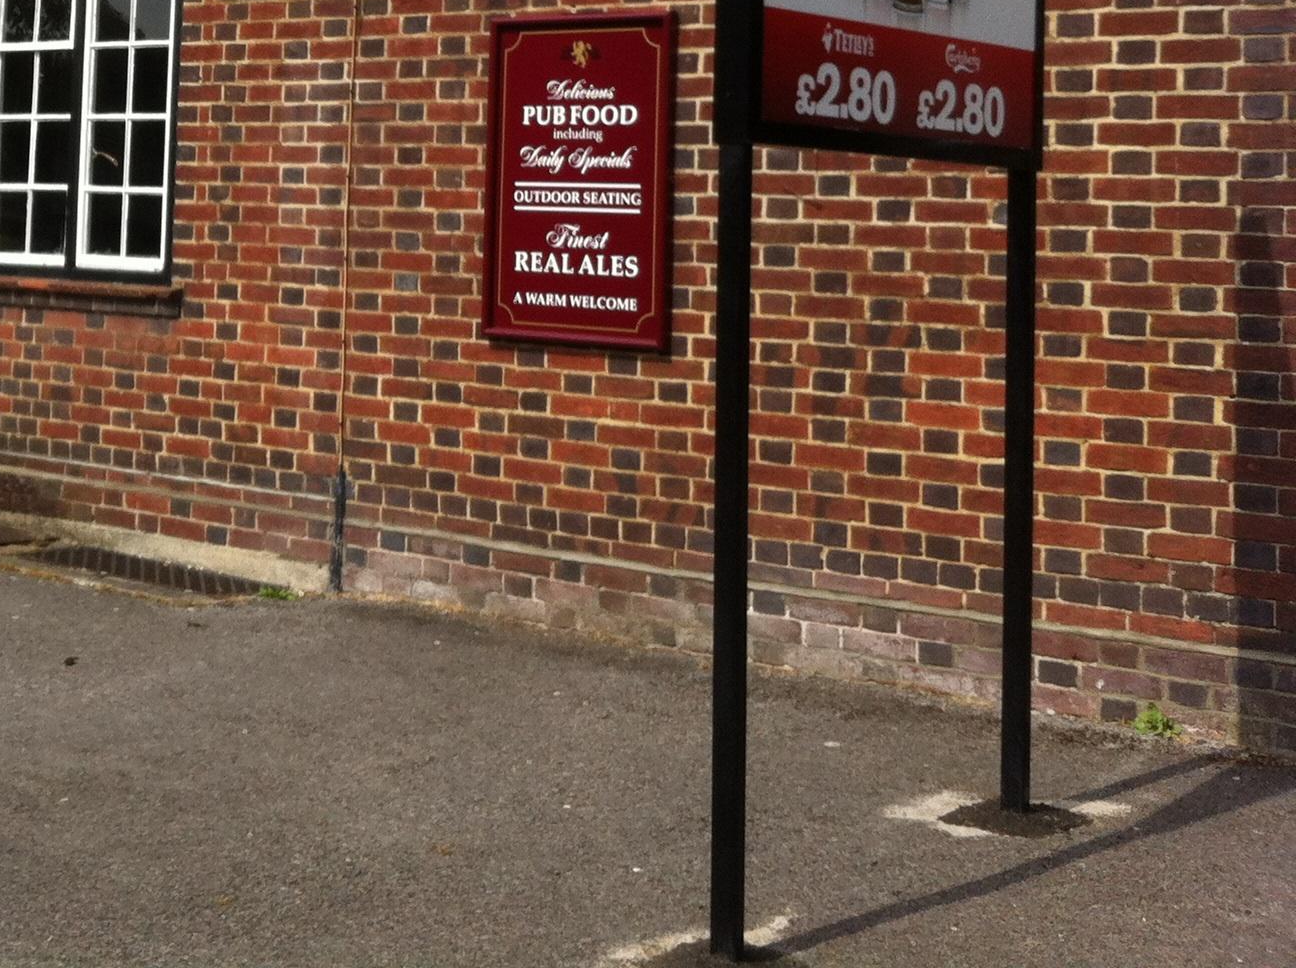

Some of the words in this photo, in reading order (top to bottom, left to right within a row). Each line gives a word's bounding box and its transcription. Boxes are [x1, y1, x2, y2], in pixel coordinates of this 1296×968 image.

[546, 79, 615, 101] Delicious
[795, 62, 896, 125] £2.80
[522, 105, 566, 126] PUB
[570, 105, 638, 126] FOOD
[916, 79, 1005, 138] £2.80
[553, 128, 603, 142] including
[519, 146, 566, 174] Daily
[568, 146, 637, 174] Specials
[513, 190, 581, 204] OUTDOOR
[583, 190, 642, 206] SEATING
[545, 223, 610, 249] Finest
[514, 251, 574, 275] REAL
[579, 255, 639, 278] ALES
[513, 291, 523, 305] A
[525, 292, 567, 308] WARM
[570, 294, 637, 312] WELCOME
